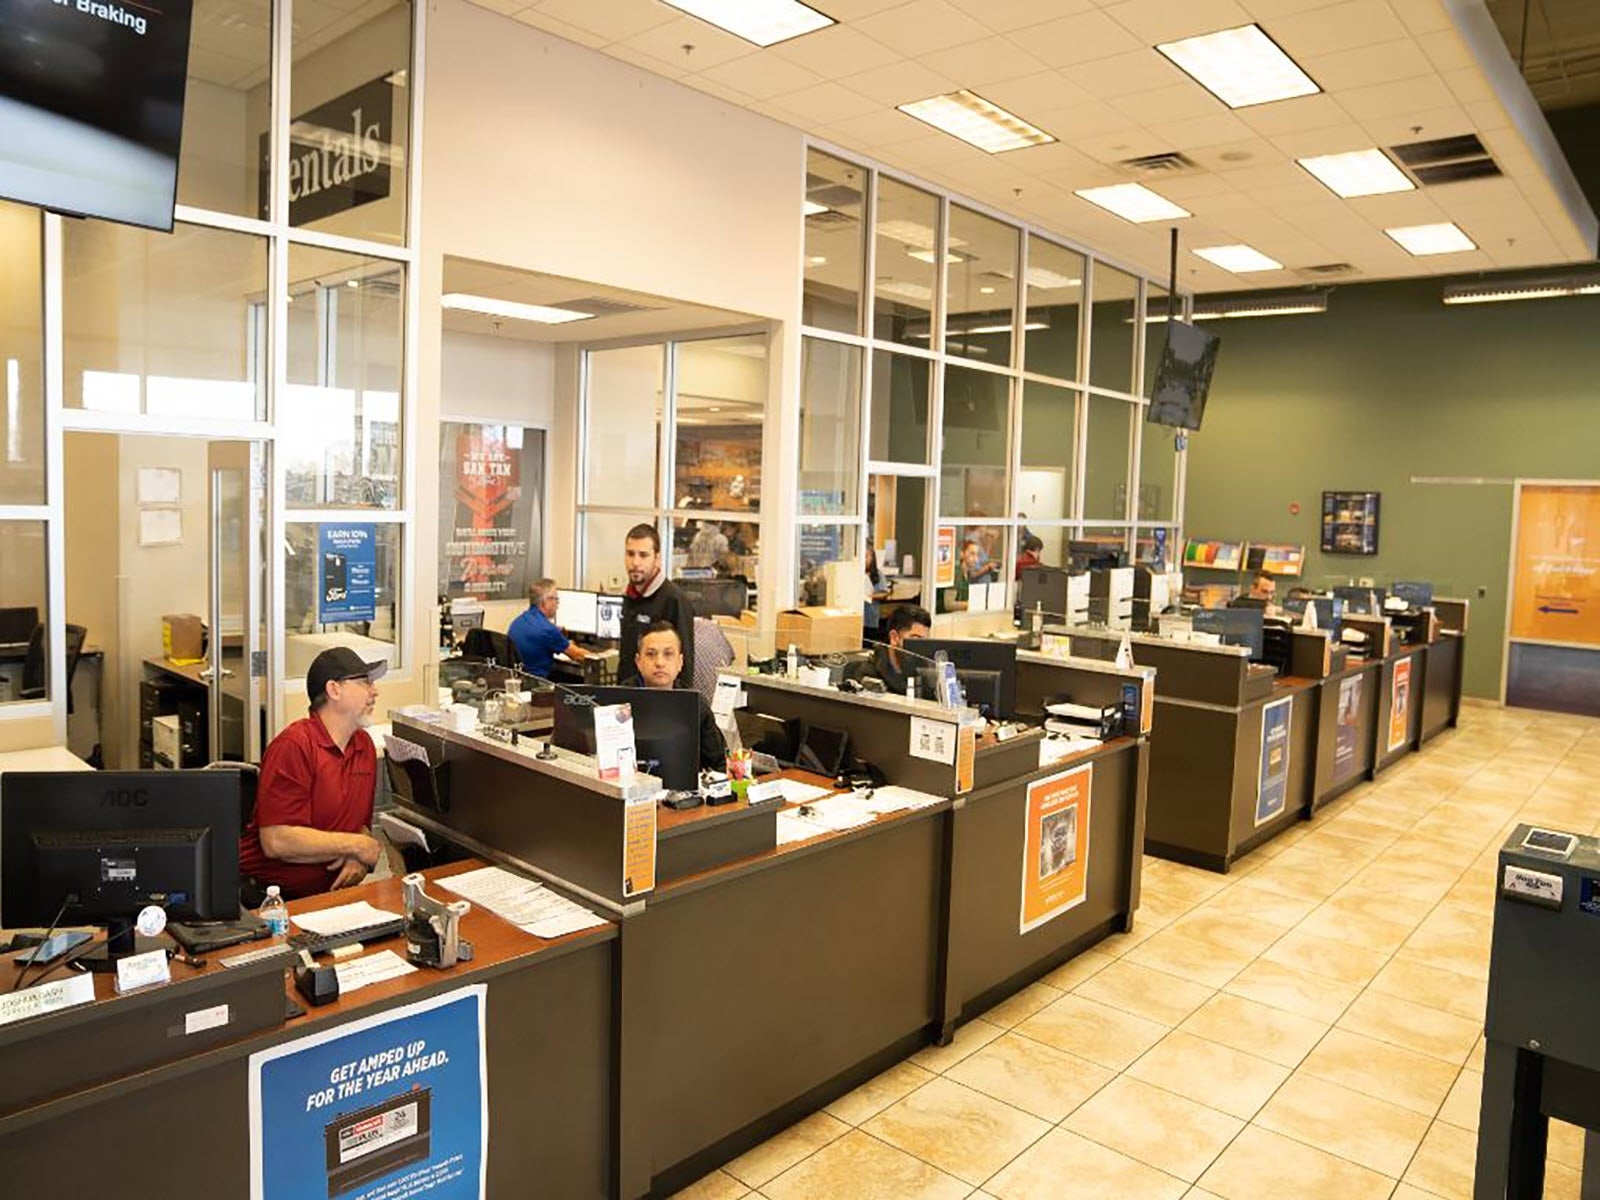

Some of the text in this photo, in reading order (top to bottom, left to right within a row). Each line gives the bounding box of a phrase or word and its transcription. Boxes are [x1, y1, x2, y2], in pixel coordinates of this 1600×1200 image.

[76, 0, 147, 35] Braking
[264, 107, 381, 212] entals
[563, 694, 596, 706] acer
[102, 788, 148, 808] AOC
[306, 1050, 449, 1112] FOR THE YEAR AHEAD.
[331, 1040, 425, 1084] GET AMPED UP
